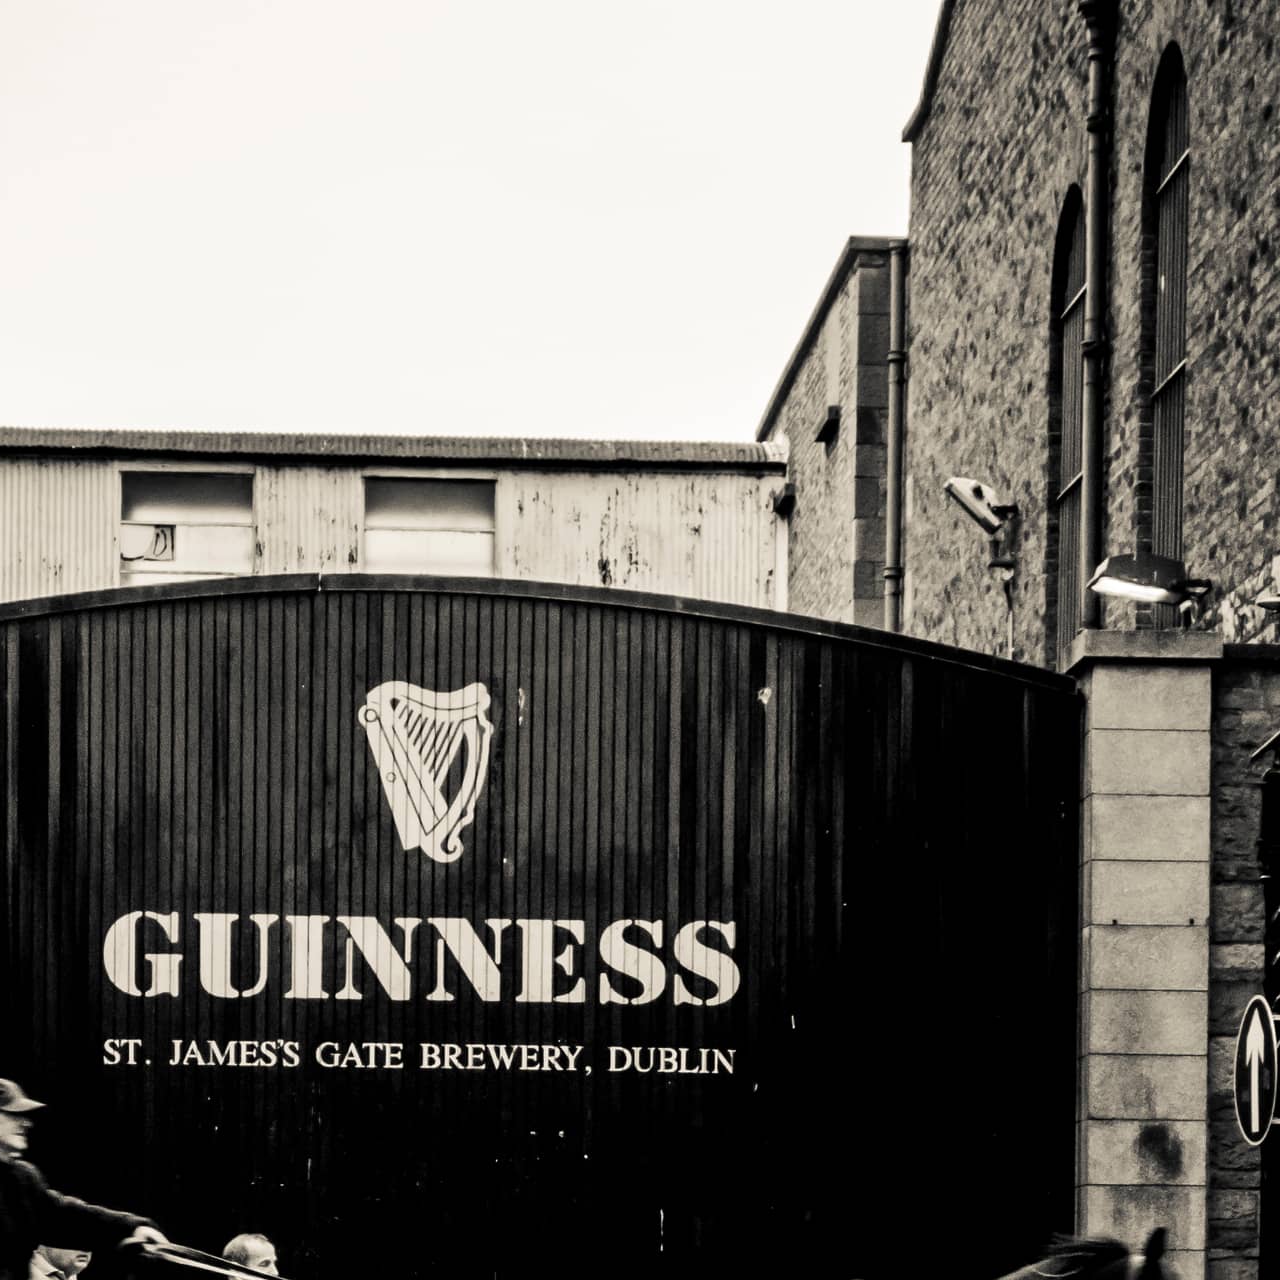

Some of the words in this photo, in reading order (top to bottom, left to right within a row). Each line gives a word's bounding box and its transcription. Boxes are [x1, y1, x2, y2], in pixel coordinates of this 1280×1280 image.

[103, 910, 741, 1007] GUINNESS
[103, 1039, 151, 1066] ST.
[169, 1039, 300, 1068] JAMES'S
[315, 1041, 404, 1069] GATE
[419, 1044, 593, 1076] BREWERY,
[608, 1047, 737, 1075] DUBLIN
